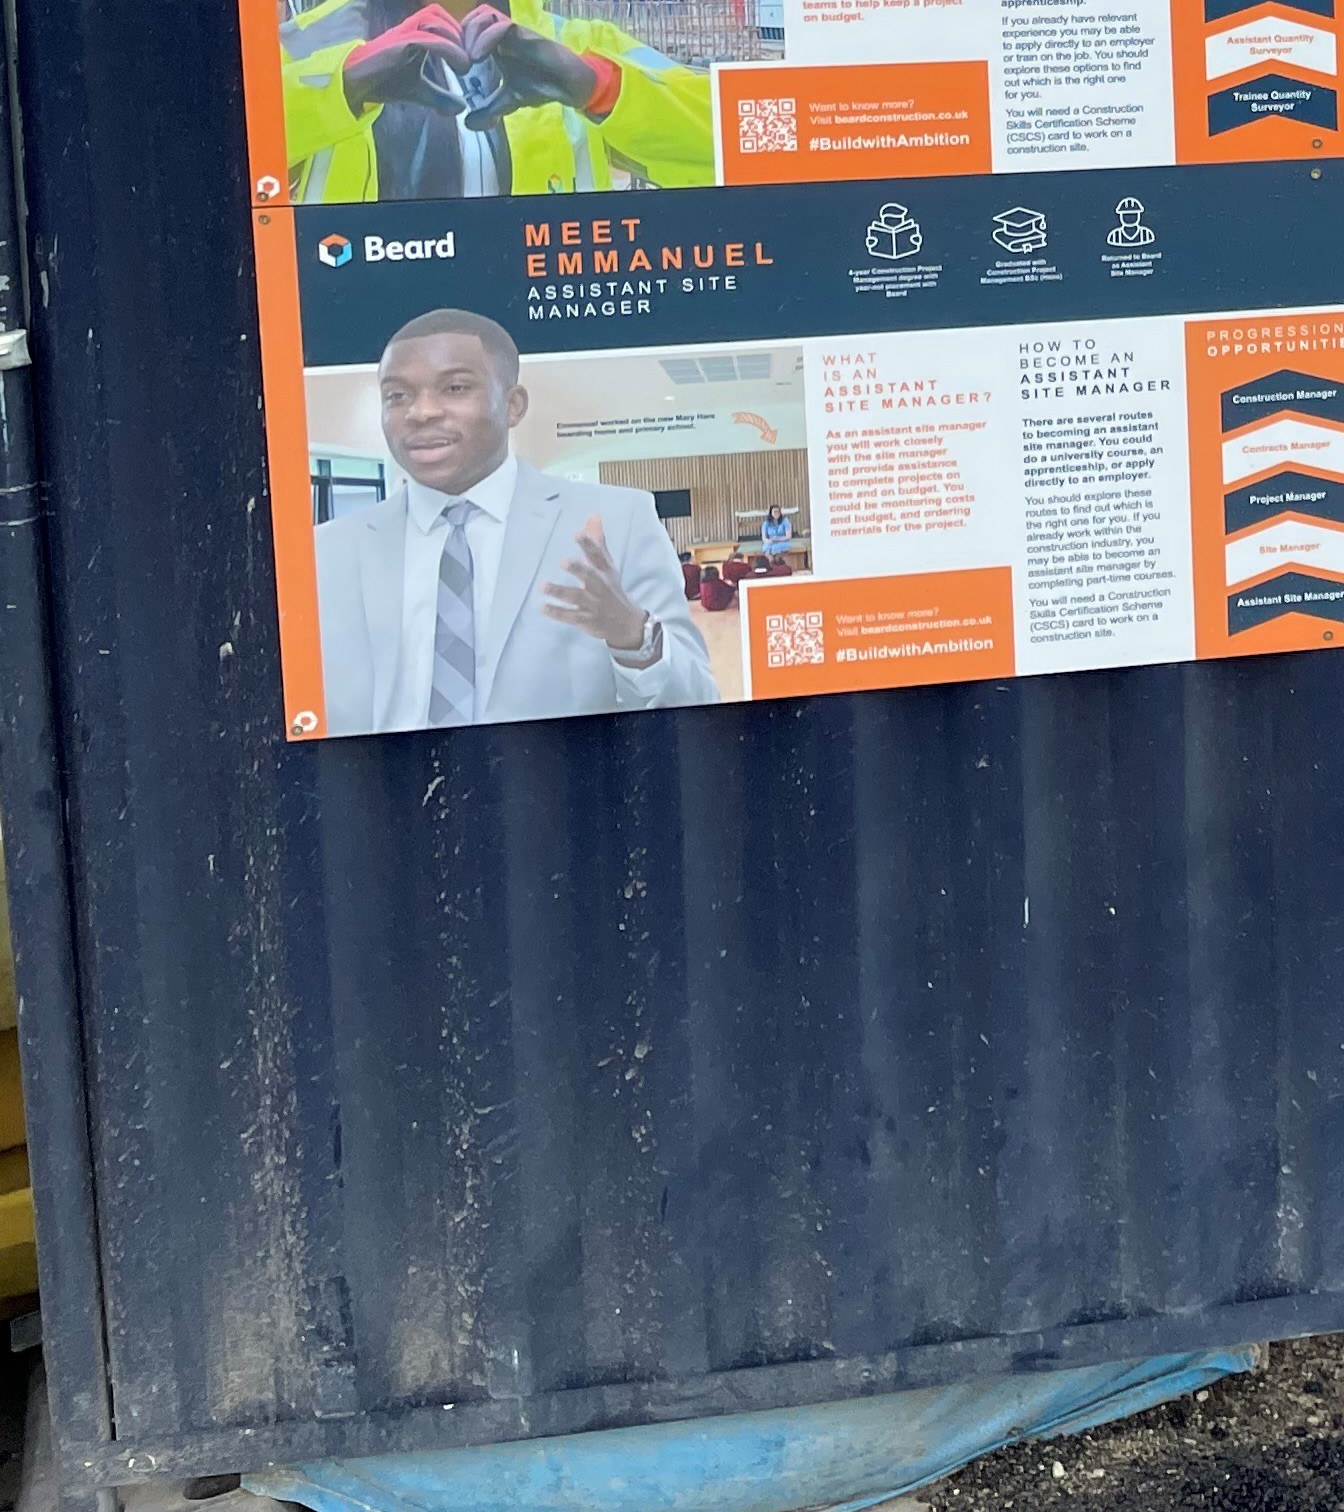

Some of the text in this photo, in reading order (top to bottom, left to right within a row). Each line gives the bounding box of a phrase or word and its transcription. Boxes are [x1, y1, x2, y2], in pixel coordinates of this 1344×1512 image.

[1233, 90, 1311, 101] Trainee Quantity
[1251, 100, 1295, 113] Surveyor
[810, 133, 970, 151] #BuildwithAmbition
[526, 219, 640, 247] MEET
[365, 232, 454, 261] Beard
[527, 242, 773, 277] EMMANUEL
[528, 276, 736, 300] ASSISTANT SITE
[529, 299, 650, 320] MANAGER
[1019, 339, 1095, 353] HOW TO
[1020, 352, 1133, 369] BECOME AN
[1021, 367, 1129, 384] ASSISTANT
[1021, 380, 1170, 400] SITE MANAGER
[1233, 390, 1337, 404] Construction Manager
[1250, 492, 1326, 505] Project Manager
[836, 638, 993, 662] #BuildwithAmbition
